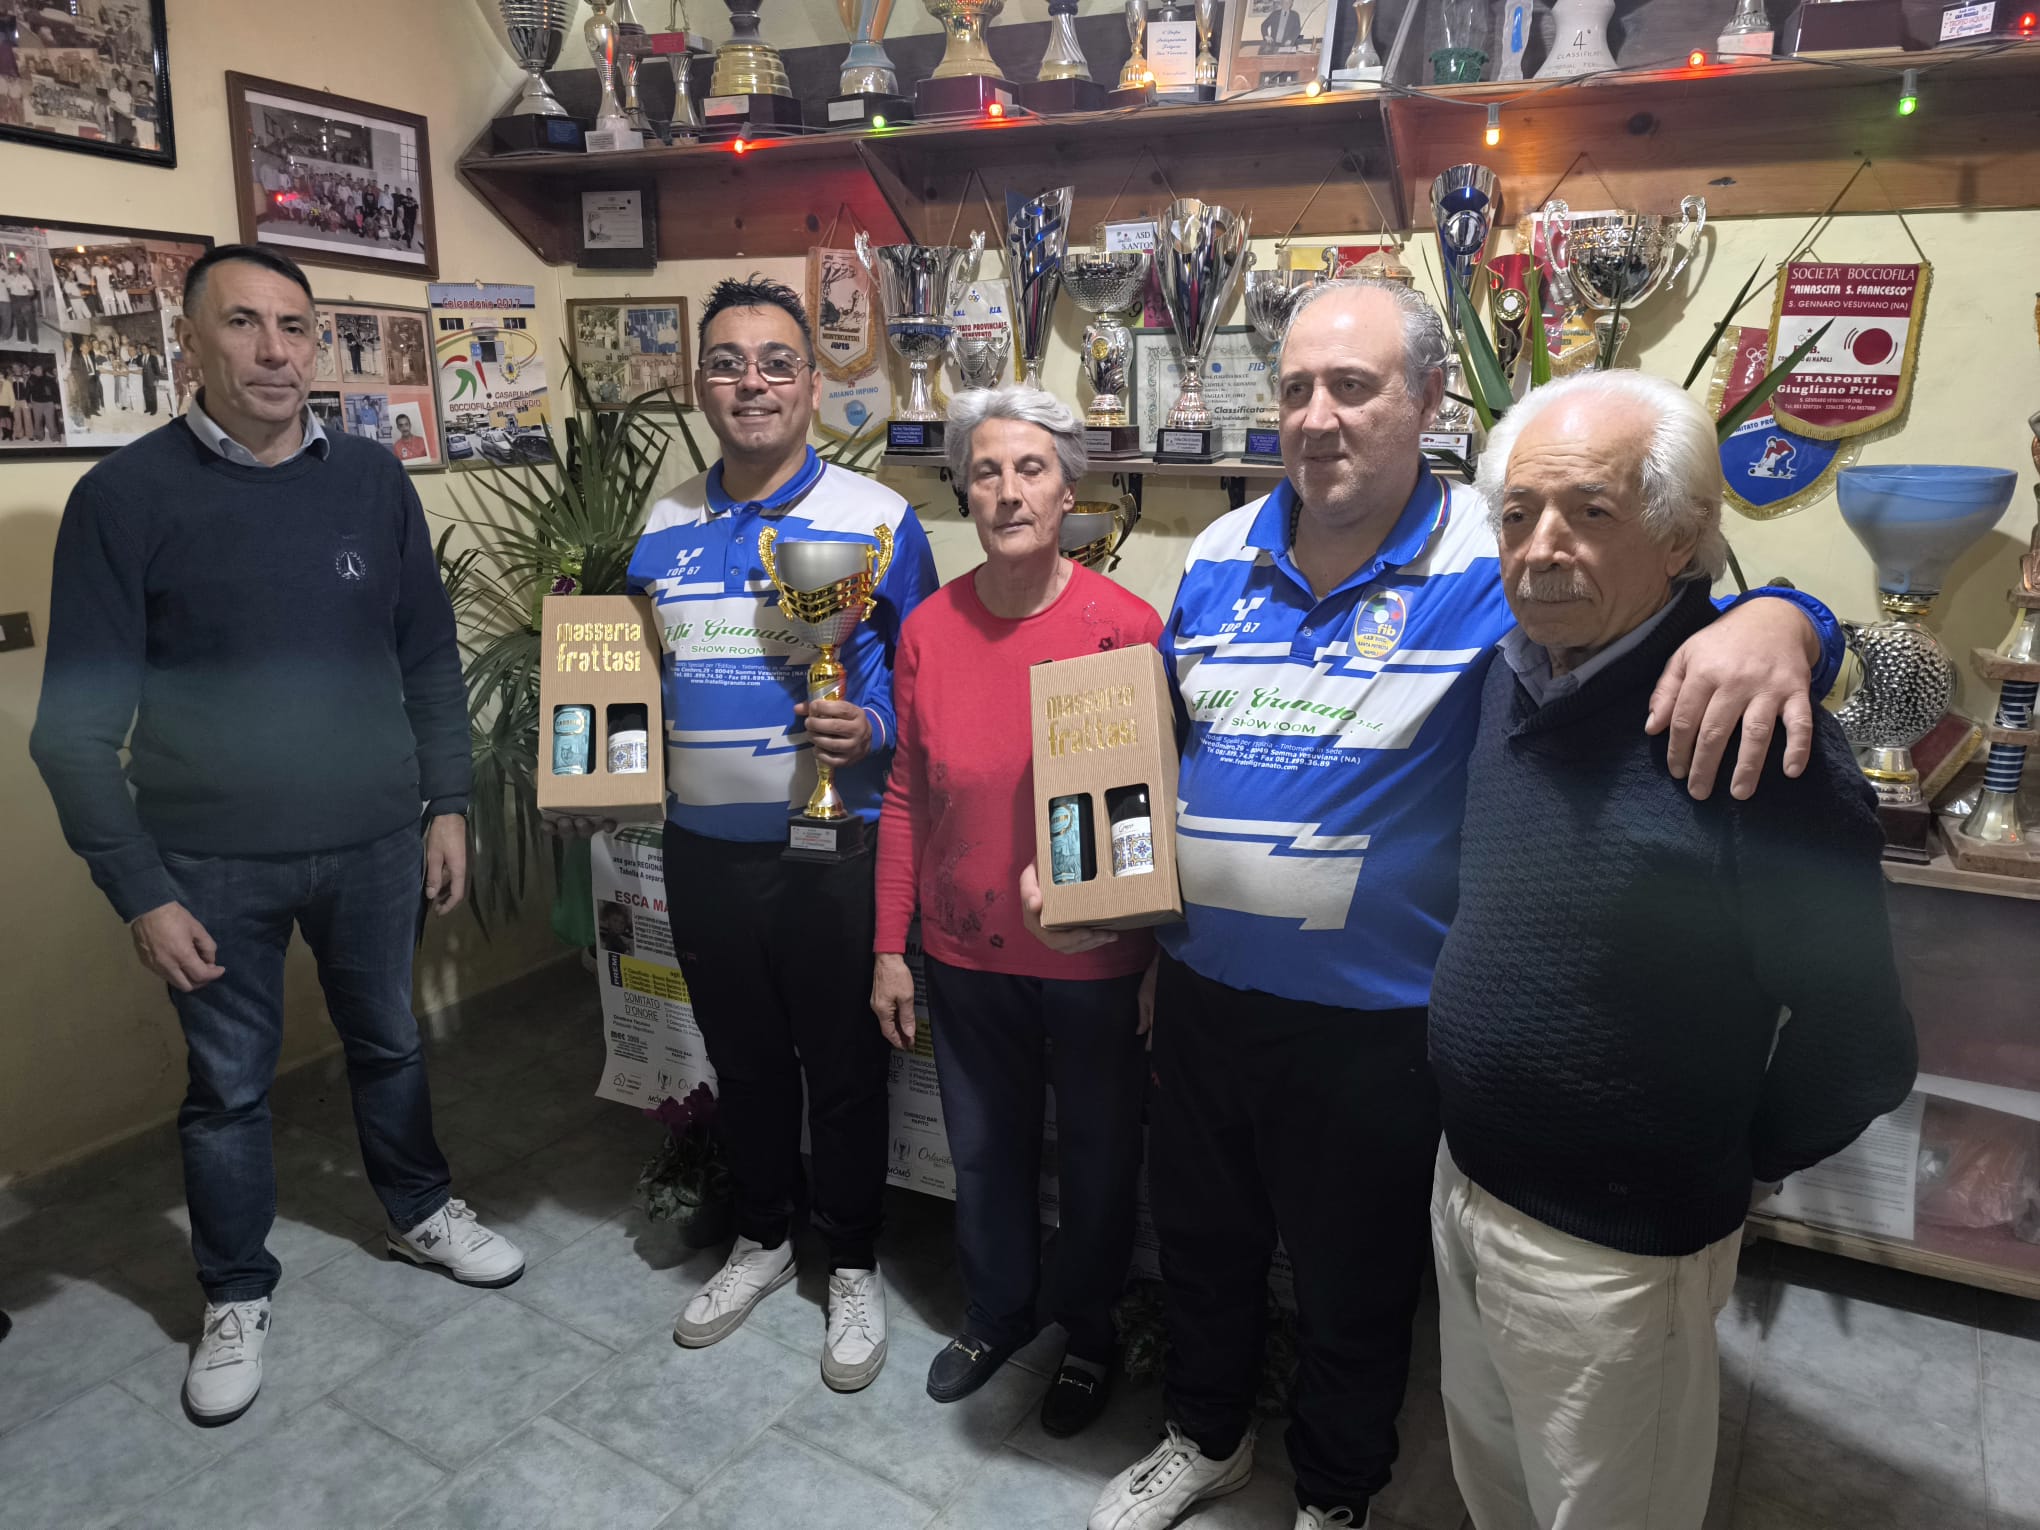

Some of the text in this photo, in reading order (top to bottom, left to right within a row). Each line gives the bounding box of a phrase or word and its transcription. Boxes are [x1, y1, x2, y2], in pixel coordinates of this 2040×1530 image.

[1135, 231, 1151, 239] ASD
[1848, 268, 1915, 281] BOCCIOFILA
[1845, 285, 1854, 295] S.
[442, 297, 521, 310] Calendario 2017
[1843, 301, 1889, 309] VESUVIANO
[1890, 302, 1909, 311] (NA)
[1247, 362, 1266, 372] FIB
[1795, 375, 1877, 384] TRASPORTI
[828, 386, 879, 400] ARIANO IRPINO
[1776, 385, 1893, 396] Giugliano Pietro
[666, 565, 701, 577] TOP 87
[556, 622, 641, 642] masseria
[701, 618, 800, 645] Granato
[1219, 621, 1261, 633] TOP 87
[691, 645, 766, 655] SHOW ROOM
[556, 642, 641, 672] frattasi
[1245, 686, 1358, 721] Granato
[1231, 717, 1272, 730] SHOW
[1048, 718, 1138, 758] frattasi
[1270, 749, 1297, 758] Somma
[1340, 756, 1361, 765] (NA)
[611, 954, 621, 986] PREMI
[624, 992, 660, 1008] COMITATO
[625, 1005, 658, 1020] D'ONORE
